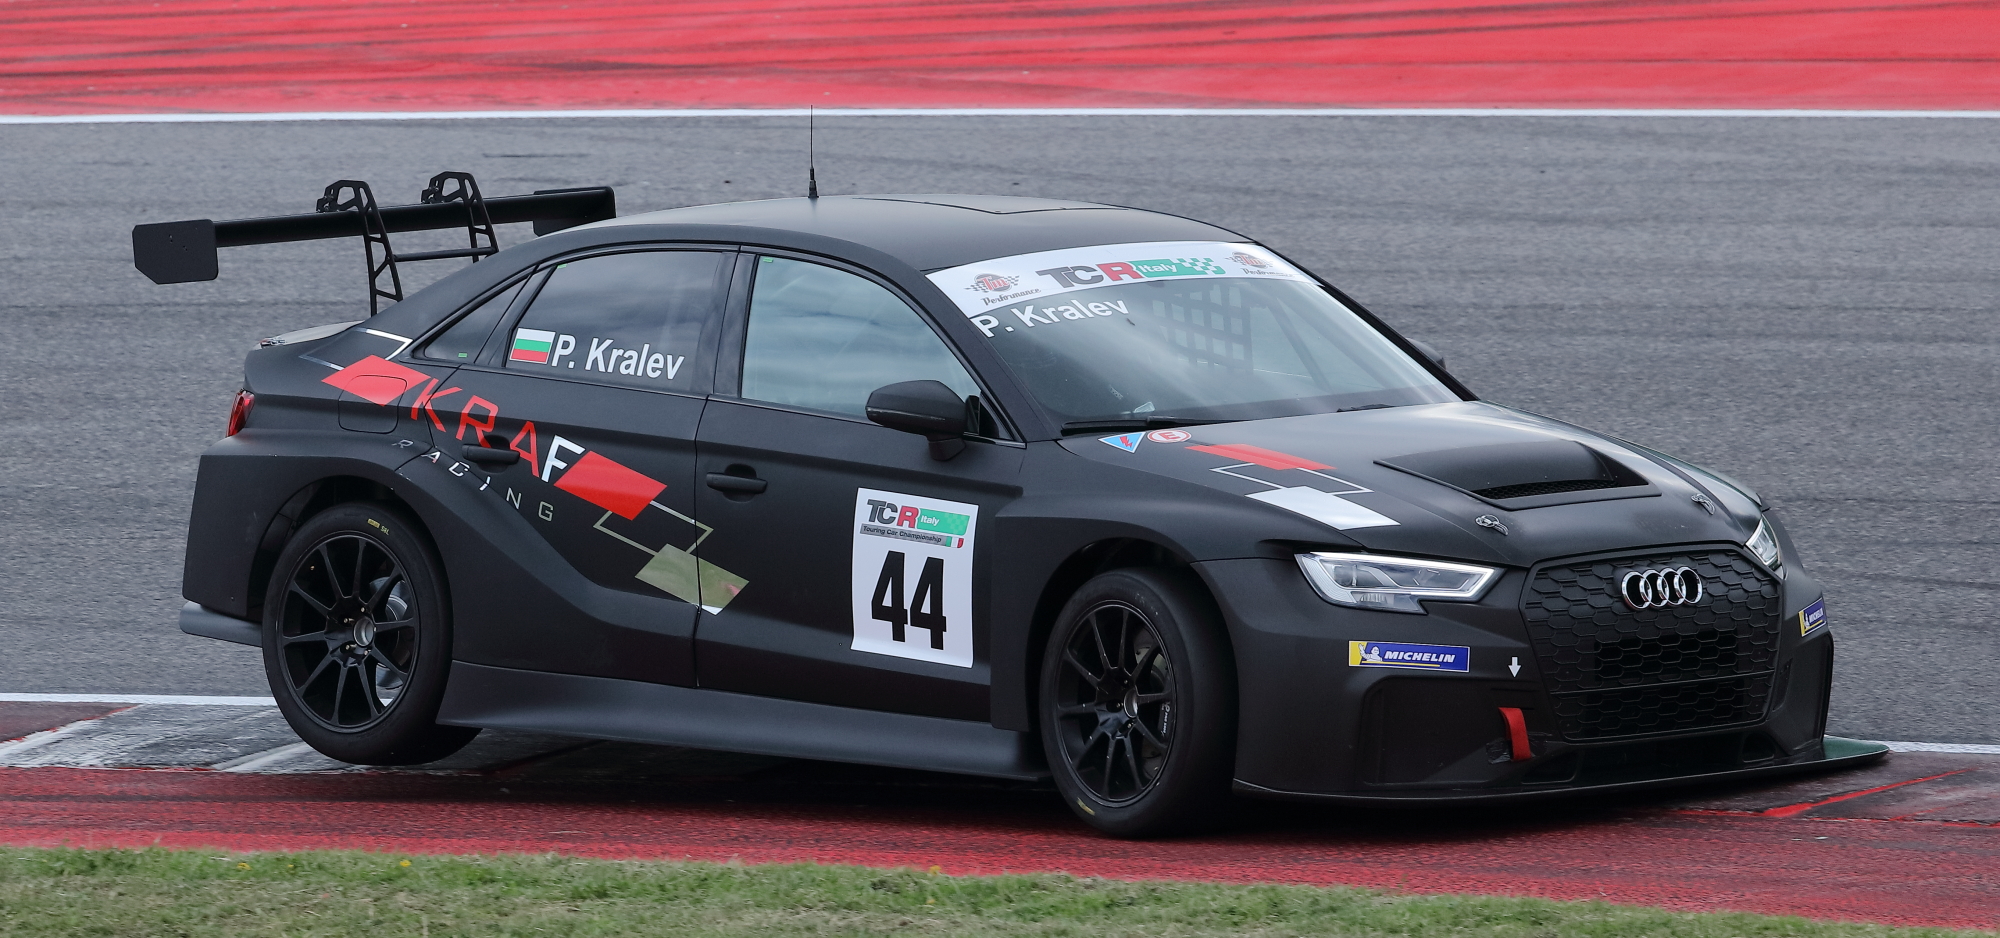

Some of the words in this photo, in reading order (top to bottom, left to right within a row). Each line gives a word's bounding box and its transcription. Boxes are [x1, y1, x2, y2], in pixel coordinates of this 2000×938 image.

[1035, 262, 1138, 289] TCR
[1140, 262, 1178, 277] Italy
[981, 288, 1042, 306] Performance
[970, 314, 1014, 338] P.
[1011, 299, 1129, 328] Kralev
[552, 334, 576, 369] P.
[584, 337, 684, 380] Kralev
[410, 377, 586, 483] KRAF
[392, 438, 554, 522] RACING
[867, 499, 919, 529] TCR
[920, 515, 940, 526] Italy
[863, 525, 886, 536] Touring
[899, 531, 942, 543] Championship
[871, 550, 947, 650] 44
[1384, 651, 1456, 663] MICHELIN
